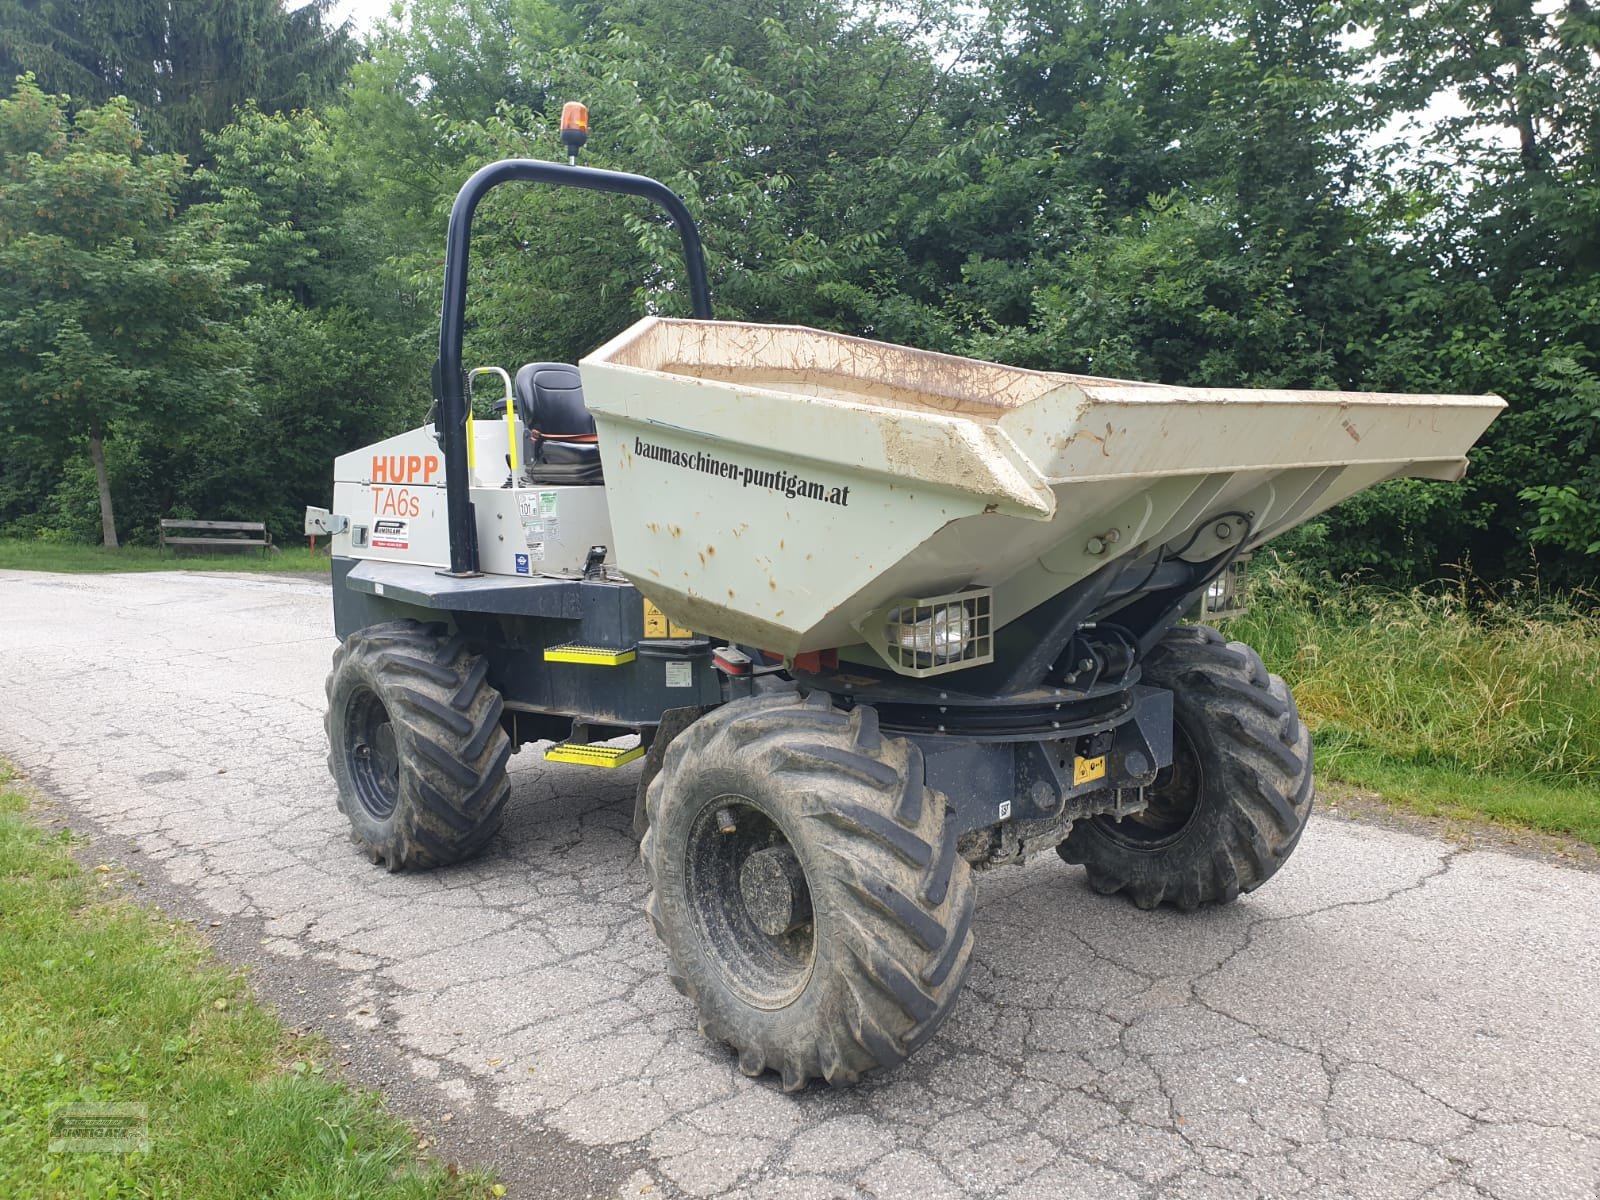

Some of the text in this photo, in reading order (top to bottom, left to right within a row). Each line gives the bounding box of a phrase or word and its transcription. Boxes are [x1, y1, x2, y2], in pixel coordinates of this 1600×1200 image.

[372, 455, 438, 483] HUPP
[635, 436, 850, 506] baumaschinen-puntigam.at
[371, 487, 419, 517] TA6s
